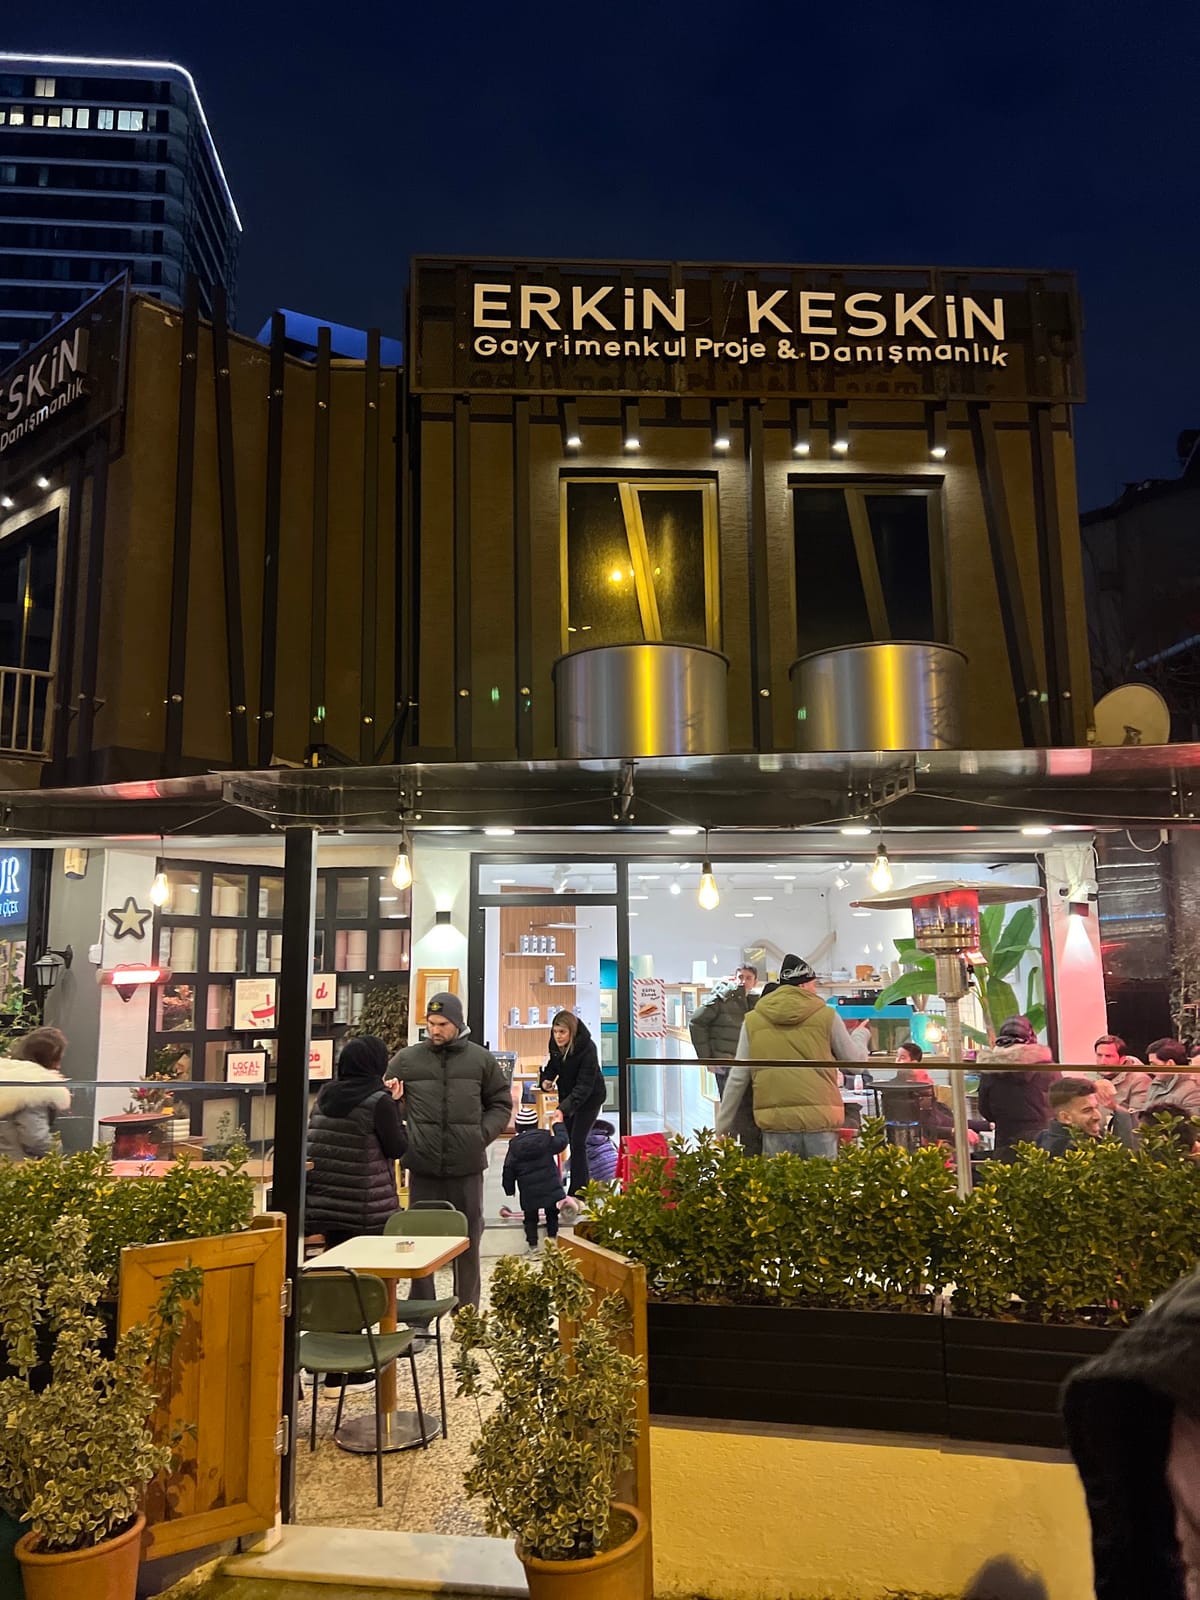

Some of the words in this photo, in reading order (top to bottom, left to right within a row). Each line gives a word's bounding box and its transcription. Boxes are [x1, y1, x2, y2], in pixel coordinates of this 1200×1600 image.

[0, 328, 81, 421] SKiN
[474, 335, 686, 362] Gayrimenkul
[695, 337, 767, 364] Proje
[777, 339, 799, 359] &
[809, 342, 1008, 367] Danışmanlık
[0, 377, 83, 453] Danışmanlık
[232, 1061, 260, 1070] LOCAL
